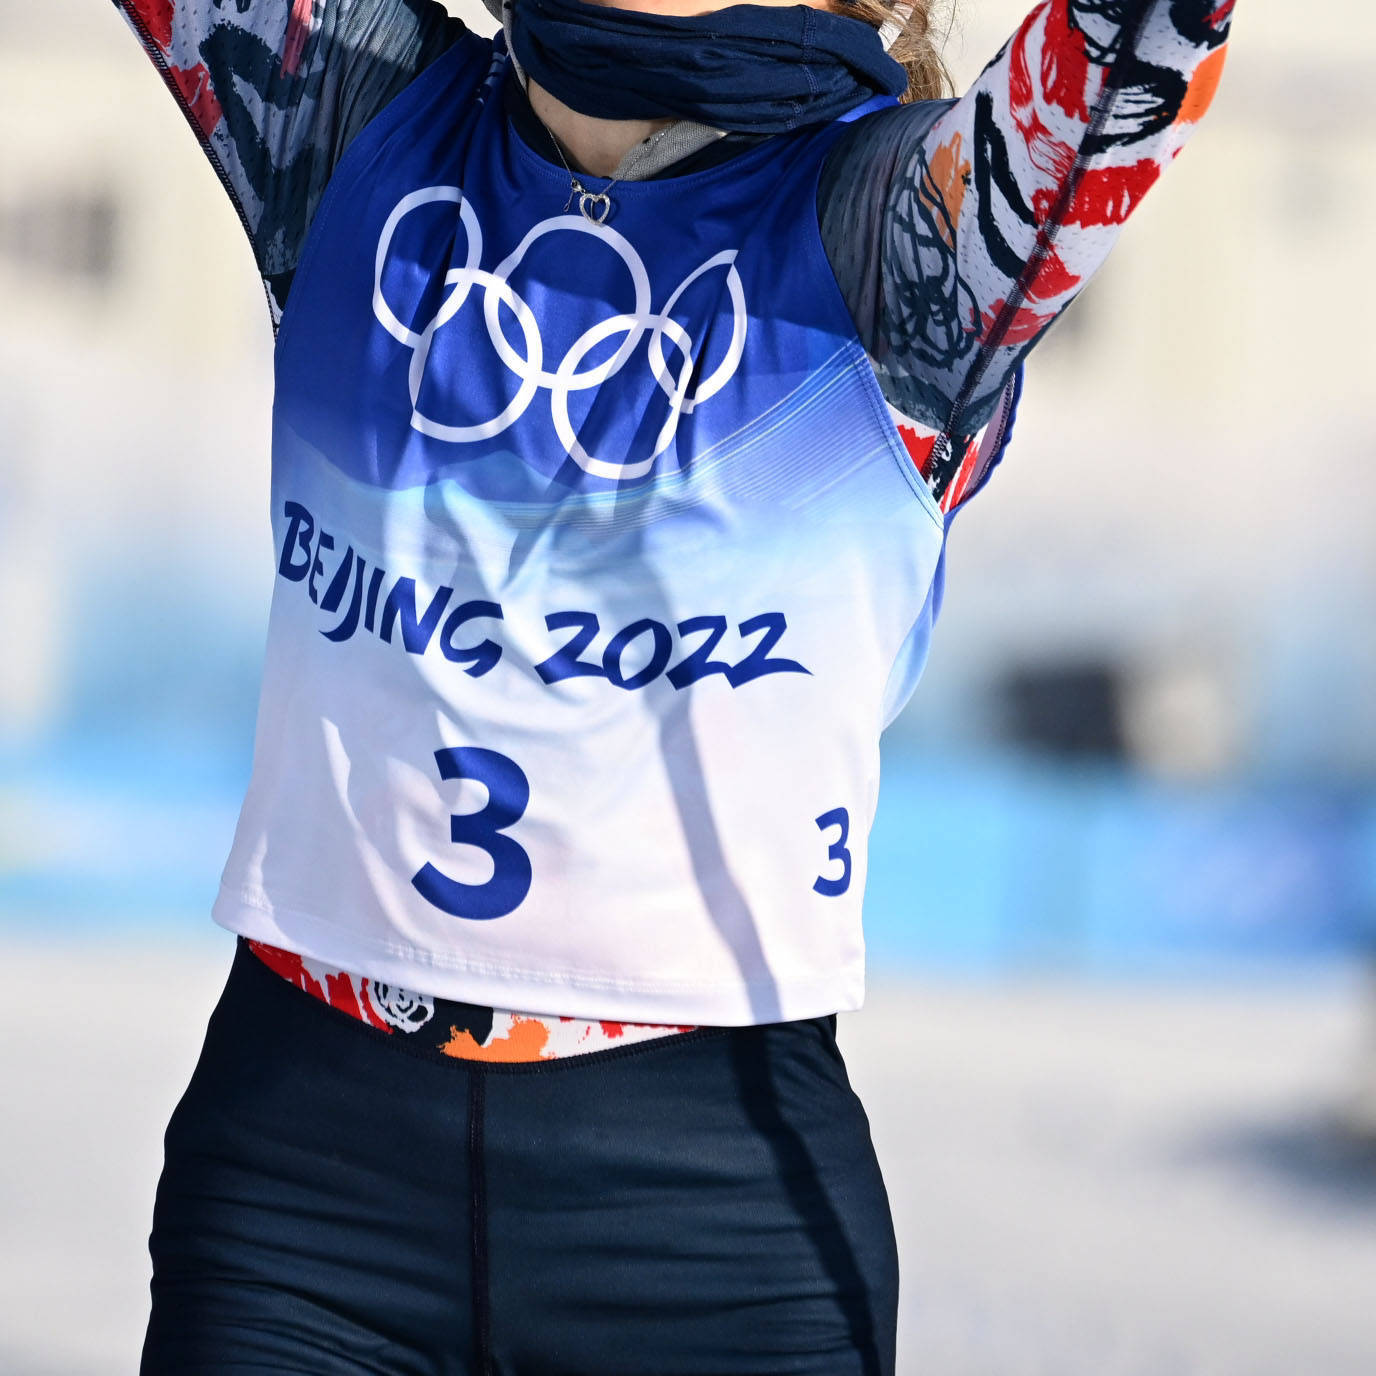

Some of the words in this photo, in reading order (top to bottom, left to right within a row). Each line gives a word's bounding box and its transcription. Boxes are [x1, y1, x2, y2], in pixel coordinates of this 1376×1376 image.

[278, 500, 504, 678] BEIJING
[534, 611, 815, 691] 2022
[411, 745, 534, 922] 3
[812, 806, 853, 899] 3
